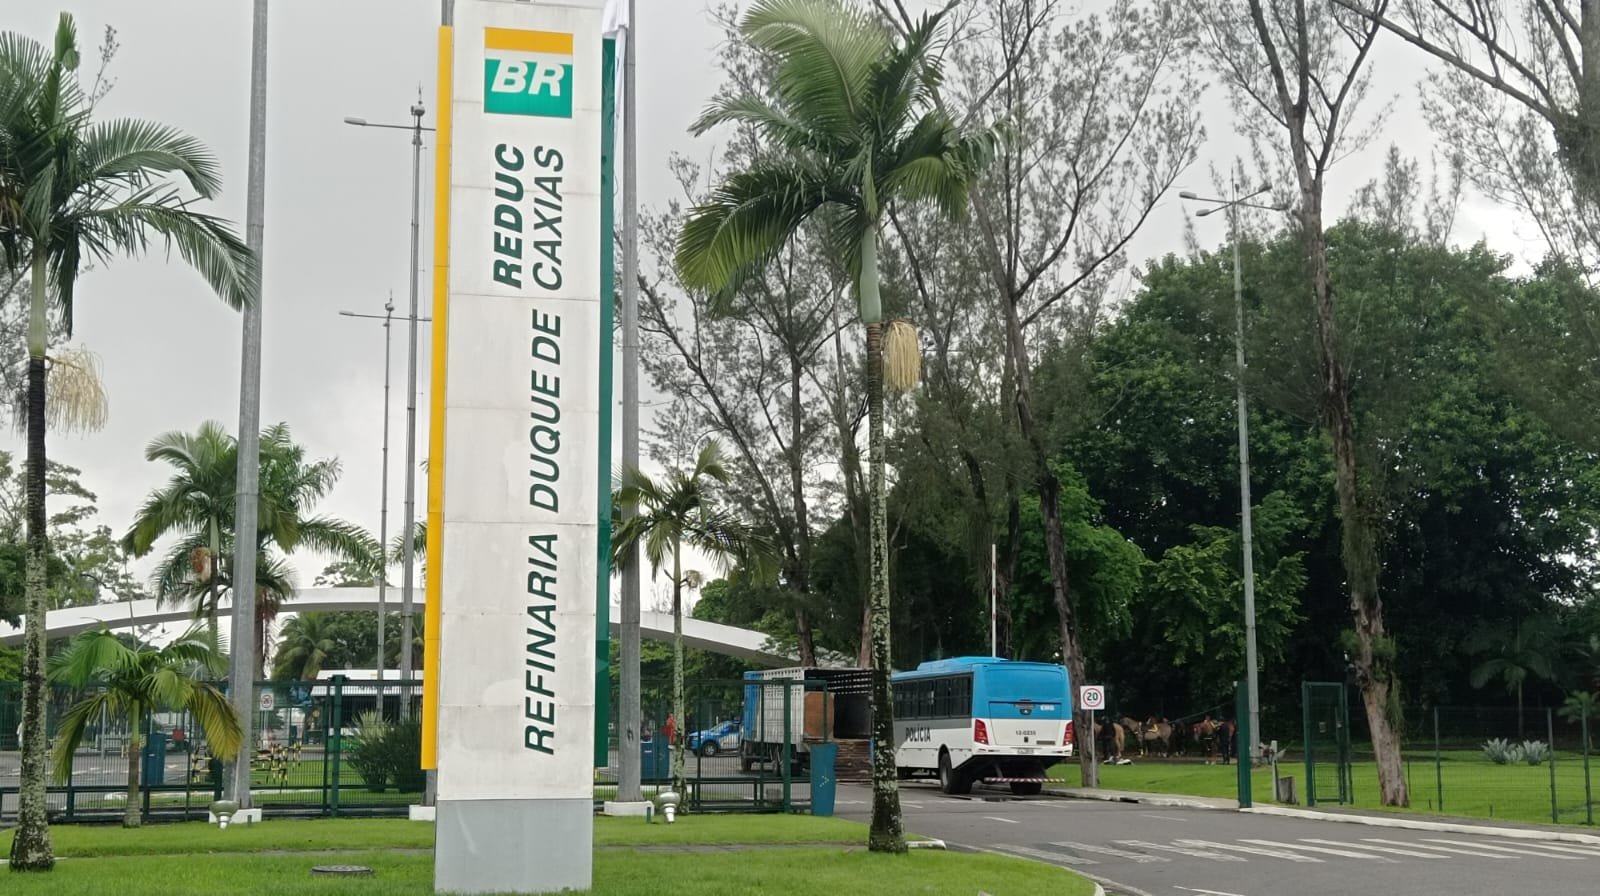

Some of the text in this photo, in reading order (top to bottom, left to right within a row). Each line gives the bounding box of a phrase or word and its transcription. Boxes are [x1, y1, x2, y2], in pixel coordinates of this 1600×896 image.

[491, 60, 564, 97] BR
[493, 143, 525, 290] REDUC
[525, 145, 564, 756] REFINARIA DUQUE DE CAXIAS
[1087, 692, 1099, 701] 20
